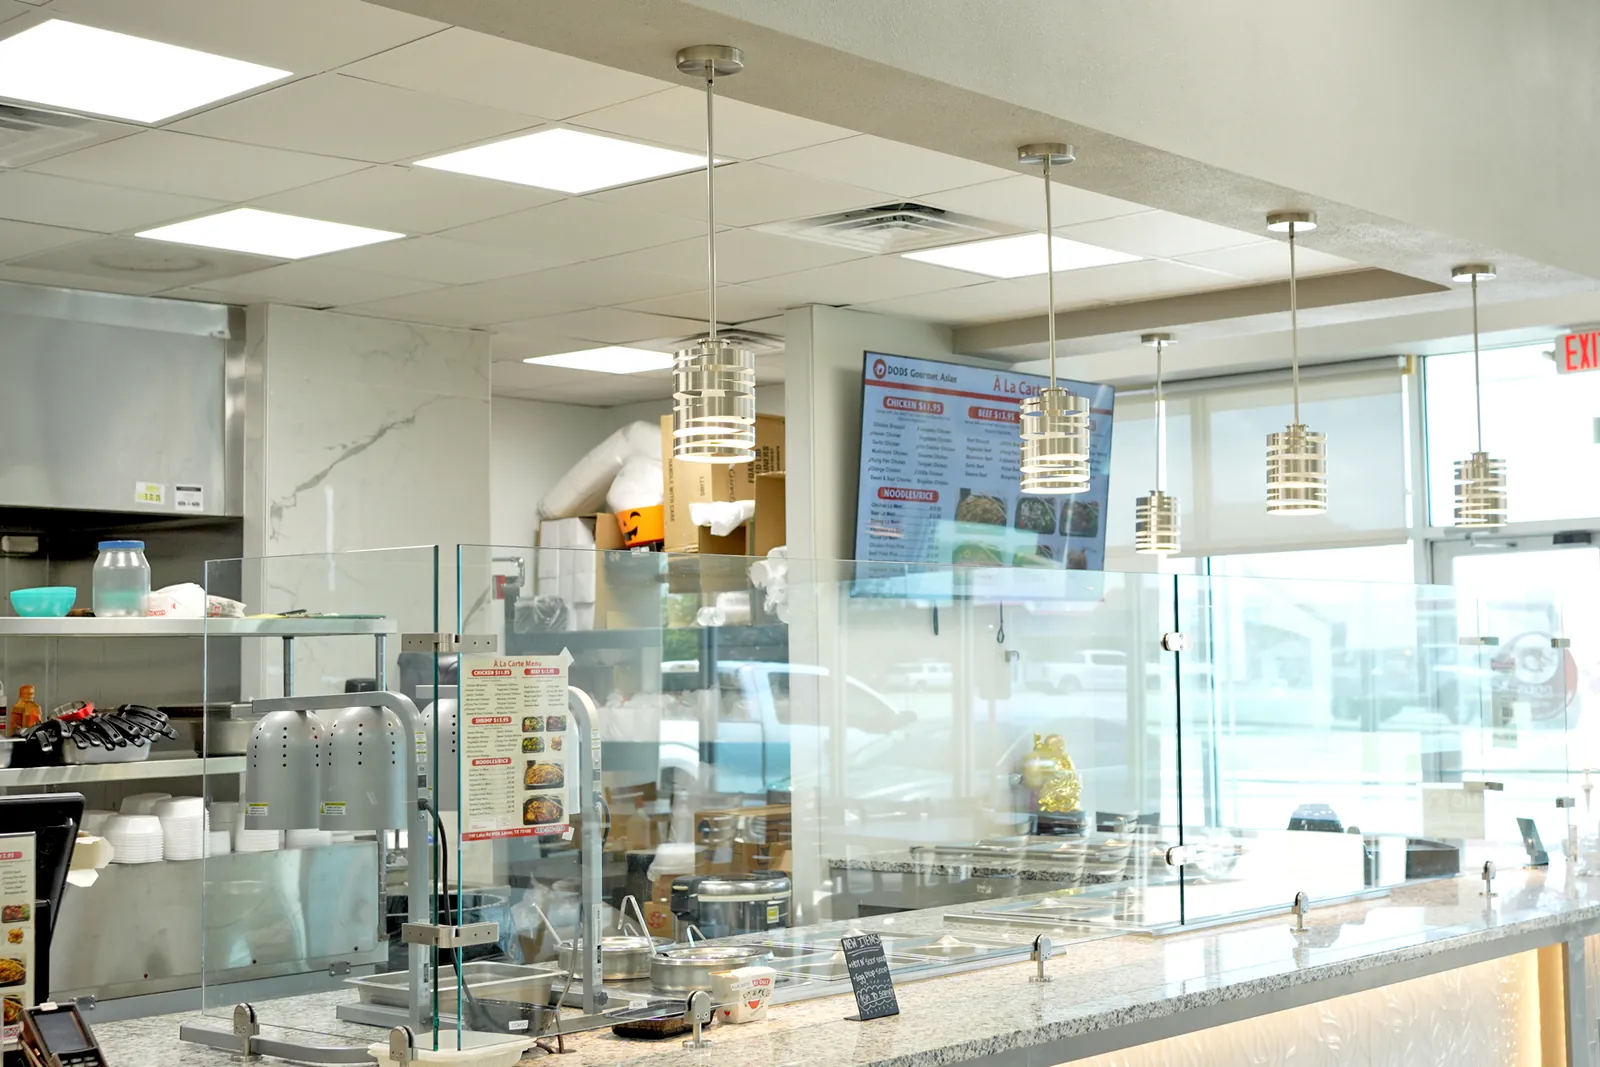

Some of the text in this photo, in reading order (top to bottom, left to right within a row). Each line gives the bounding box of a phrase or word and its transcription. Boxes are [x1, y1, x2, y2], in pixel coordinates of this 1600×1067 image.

[1565, 332, 1600, 371] EXI
[887, 365, 908, 376] DODS
[910, 369, 938, 381] Gourmet
[1004, 382, 1016, 394] La
[1018, 383, 1042, 397] Cart
[886, 398, 917, 410] CHICKEN
[978, 408, 992, 418] BEEF
[884, 489, 933, 500] NOODLES/RICE
[843, 938, 858, 950] NEW
